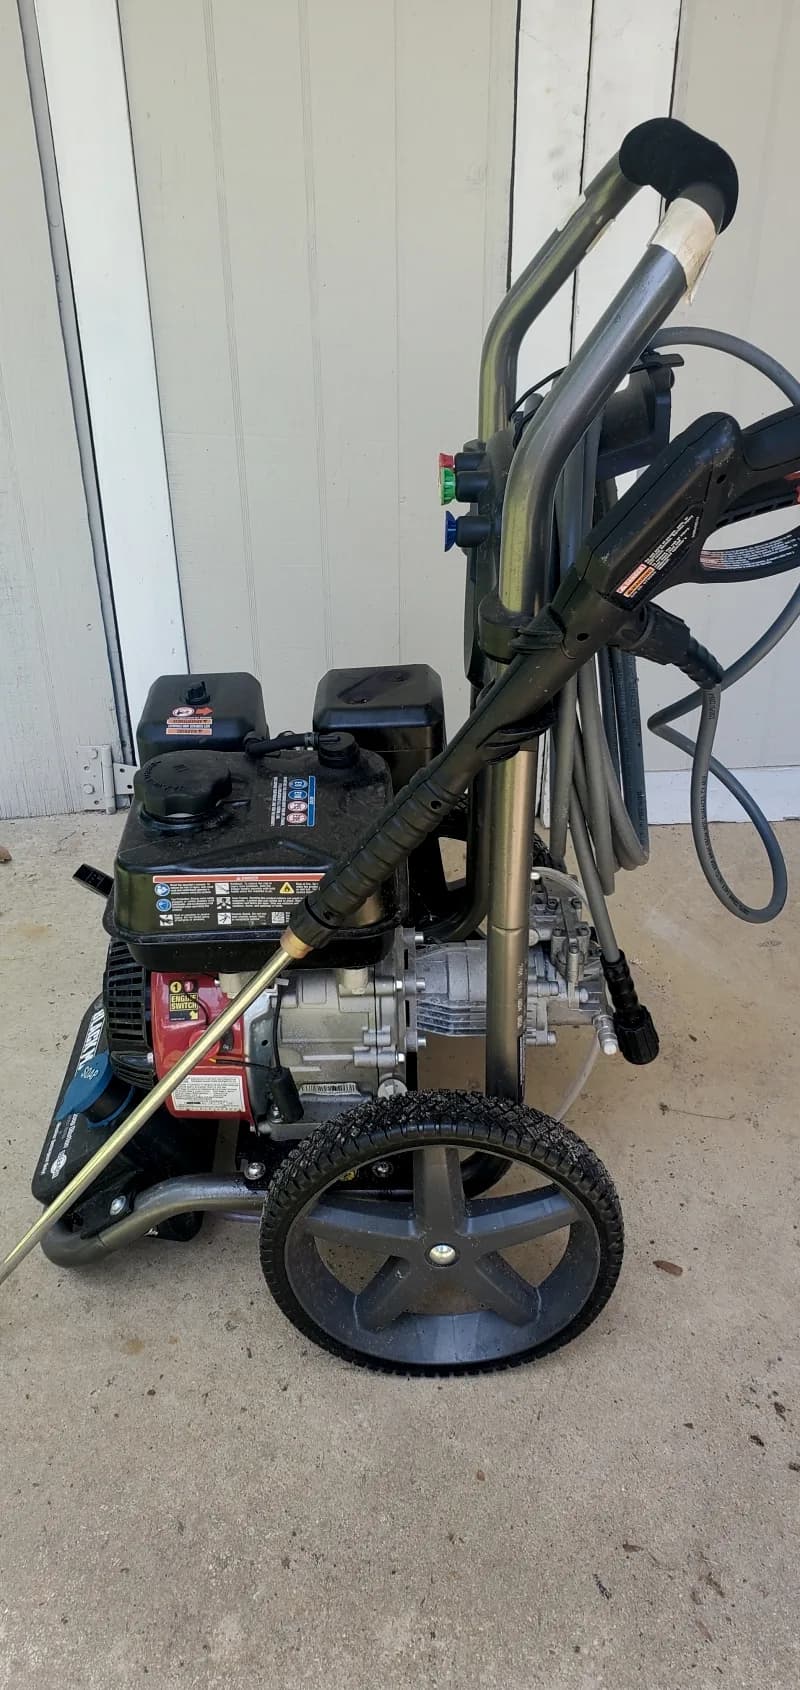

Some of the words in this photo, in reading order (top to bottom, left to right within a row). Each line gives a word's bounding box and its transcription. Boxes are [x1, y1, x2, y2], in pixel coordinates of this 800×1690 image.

[171, 995, 197, 1003] ENGIE
[171, 1002, 197, 1010] SWITCH
[77, 1008, 105, 1071] BLACKM
